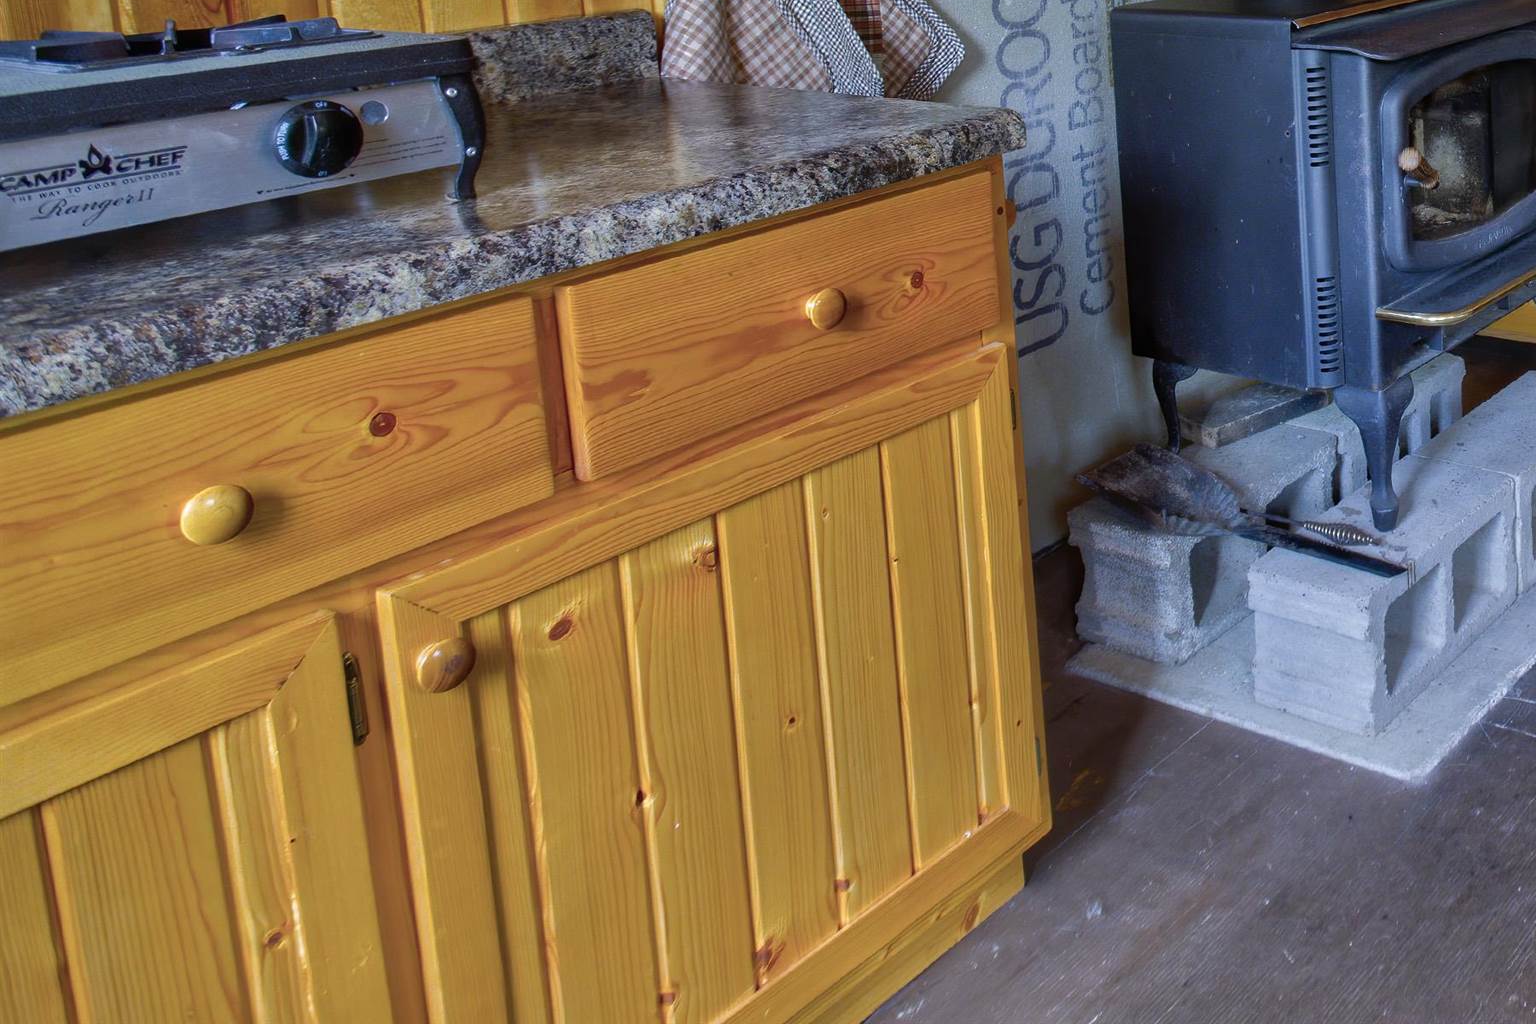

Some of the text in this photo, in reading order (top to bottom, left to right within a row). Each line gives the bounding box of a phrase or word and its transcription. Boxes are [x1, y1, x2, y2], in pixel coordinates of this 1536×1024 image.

[0, 150, 186, 193] CAMP CHEF
[11, 195, 33, 204] THE
[39, 189, 62, 199] WAY
[87, 181, 119, 192] COOK
[1072, 143, 1117, 318] Cement
[1009, 217, 1071, 359] USG
